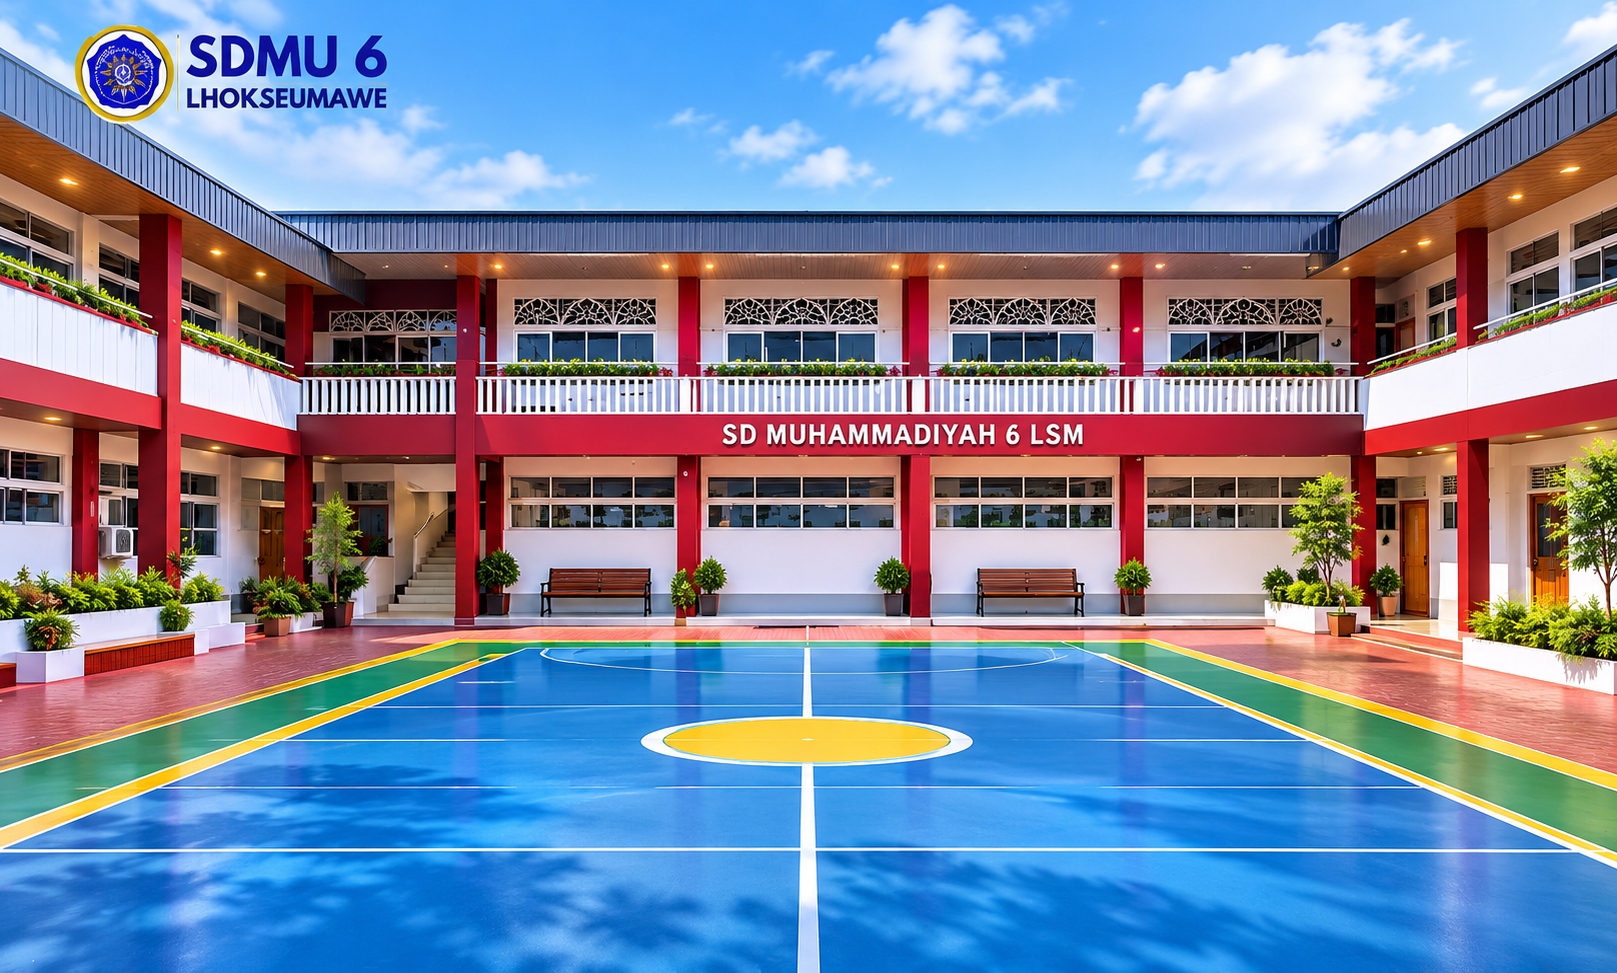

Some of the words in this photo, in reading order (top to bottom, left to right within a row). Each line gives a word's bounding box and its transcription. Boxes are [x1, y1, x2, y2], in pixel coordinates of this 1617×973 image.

[722, 423, 757, 445] SD
[766, 423, 995, 445] MUHAMMADIYAH
[1005, 423, 1020, 445] 6
[1030, 423, 1083, 445] LSM
